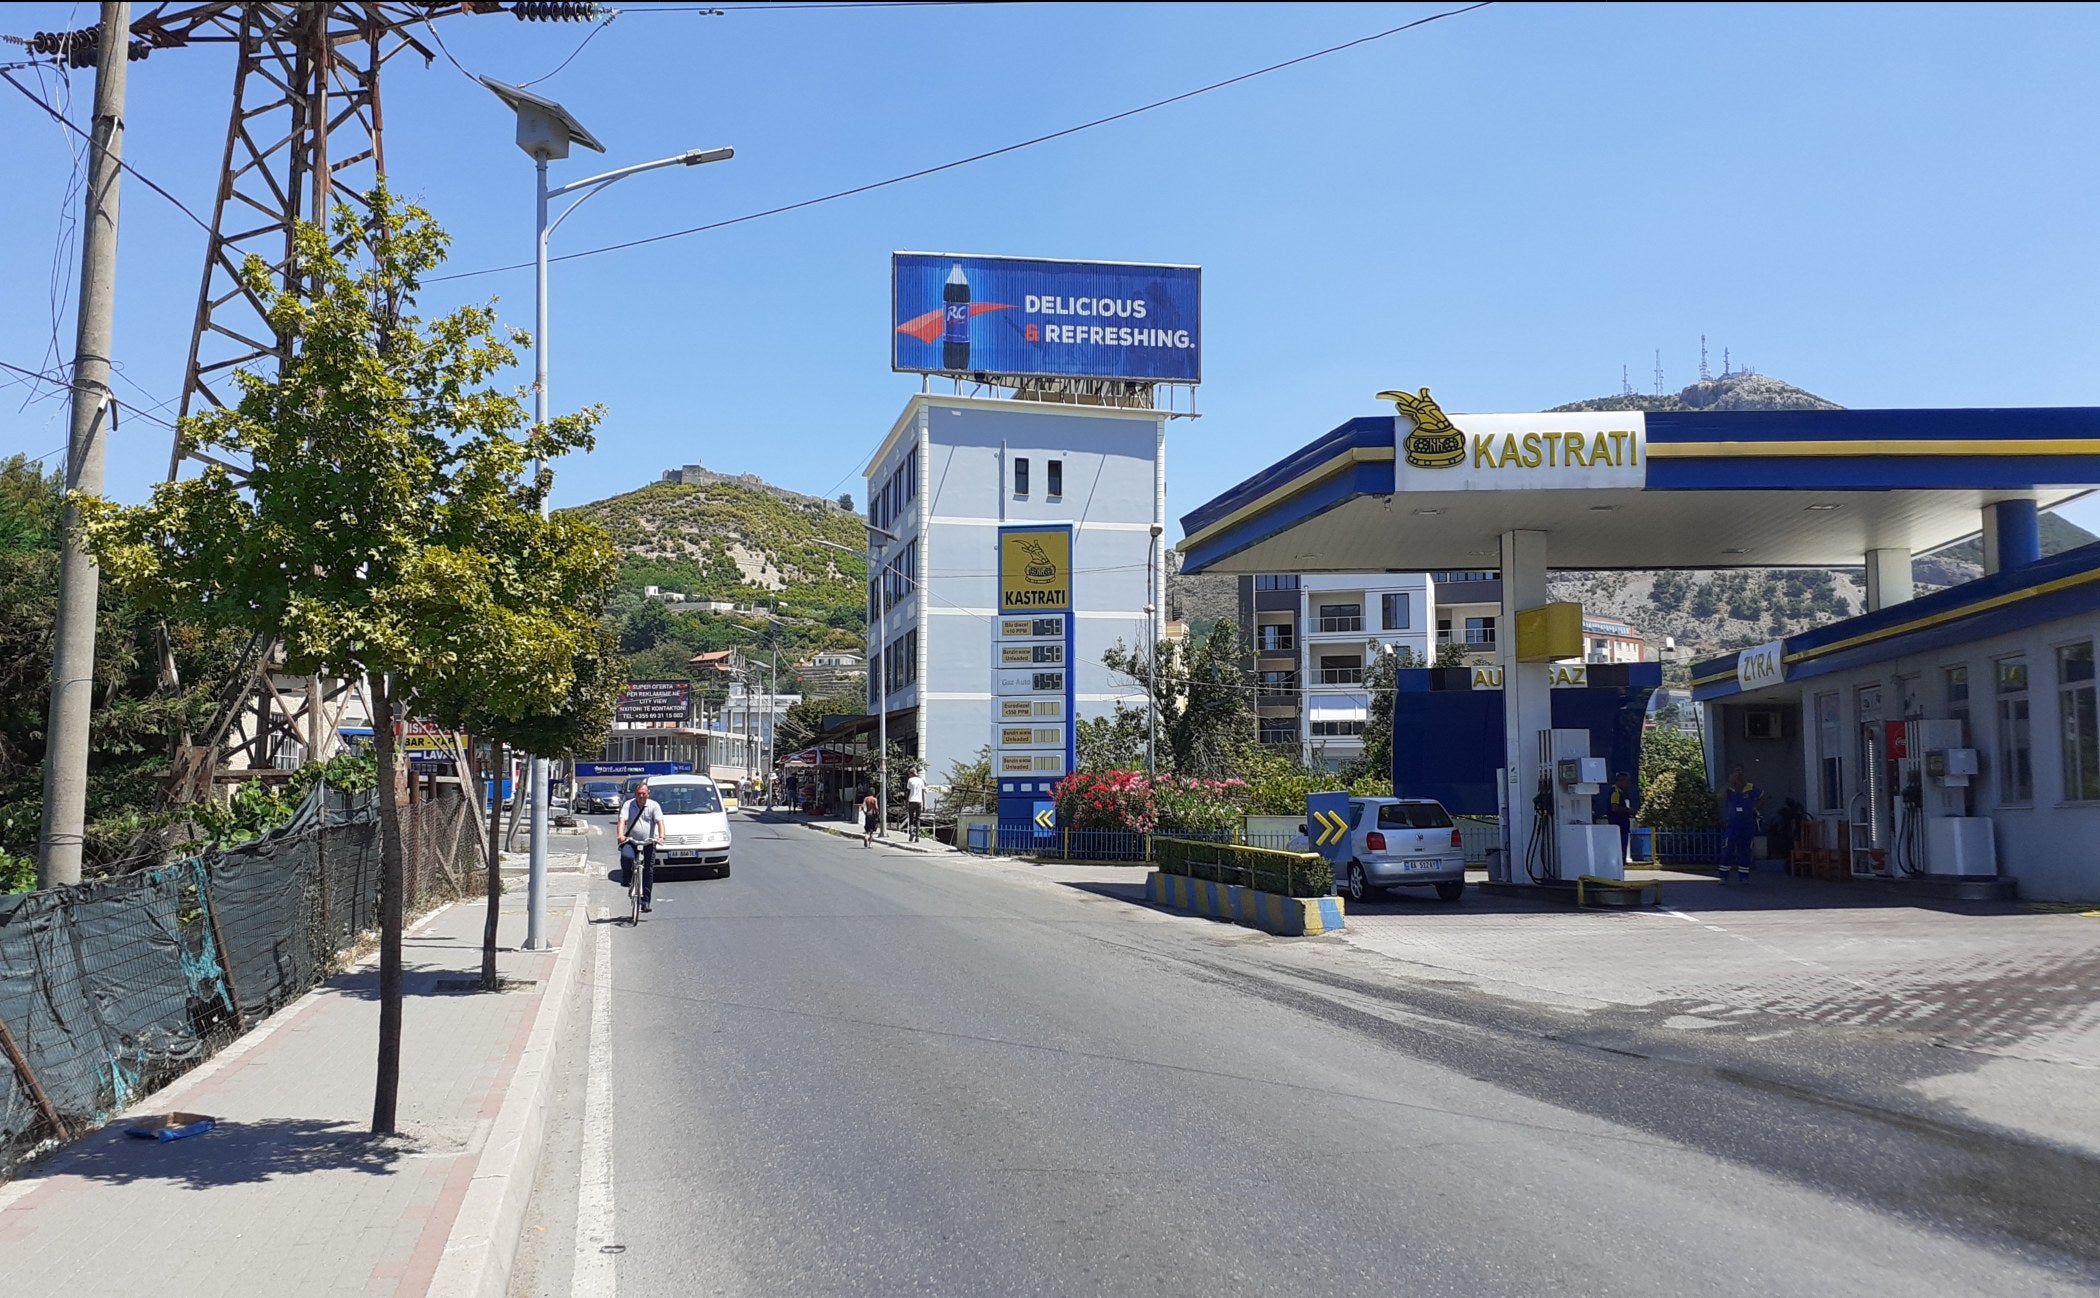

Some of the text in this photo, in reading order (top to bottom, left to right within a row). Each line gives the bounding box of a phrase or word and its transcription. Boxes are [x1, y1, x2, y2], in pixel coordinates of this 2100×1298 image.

[946, 305, 967, 322] RC
[1025, 295, 1147, 318] DELICIOUS
[1045, 324, 1196, 349] REFRESHING.
[1473, 430, 1638, 469] KASTRATI
[1005, 589, 1066, 606] KASTRATI
[1743, 650, 1775, 682] ZYRA
[405, 737, 425, 747] BAR
